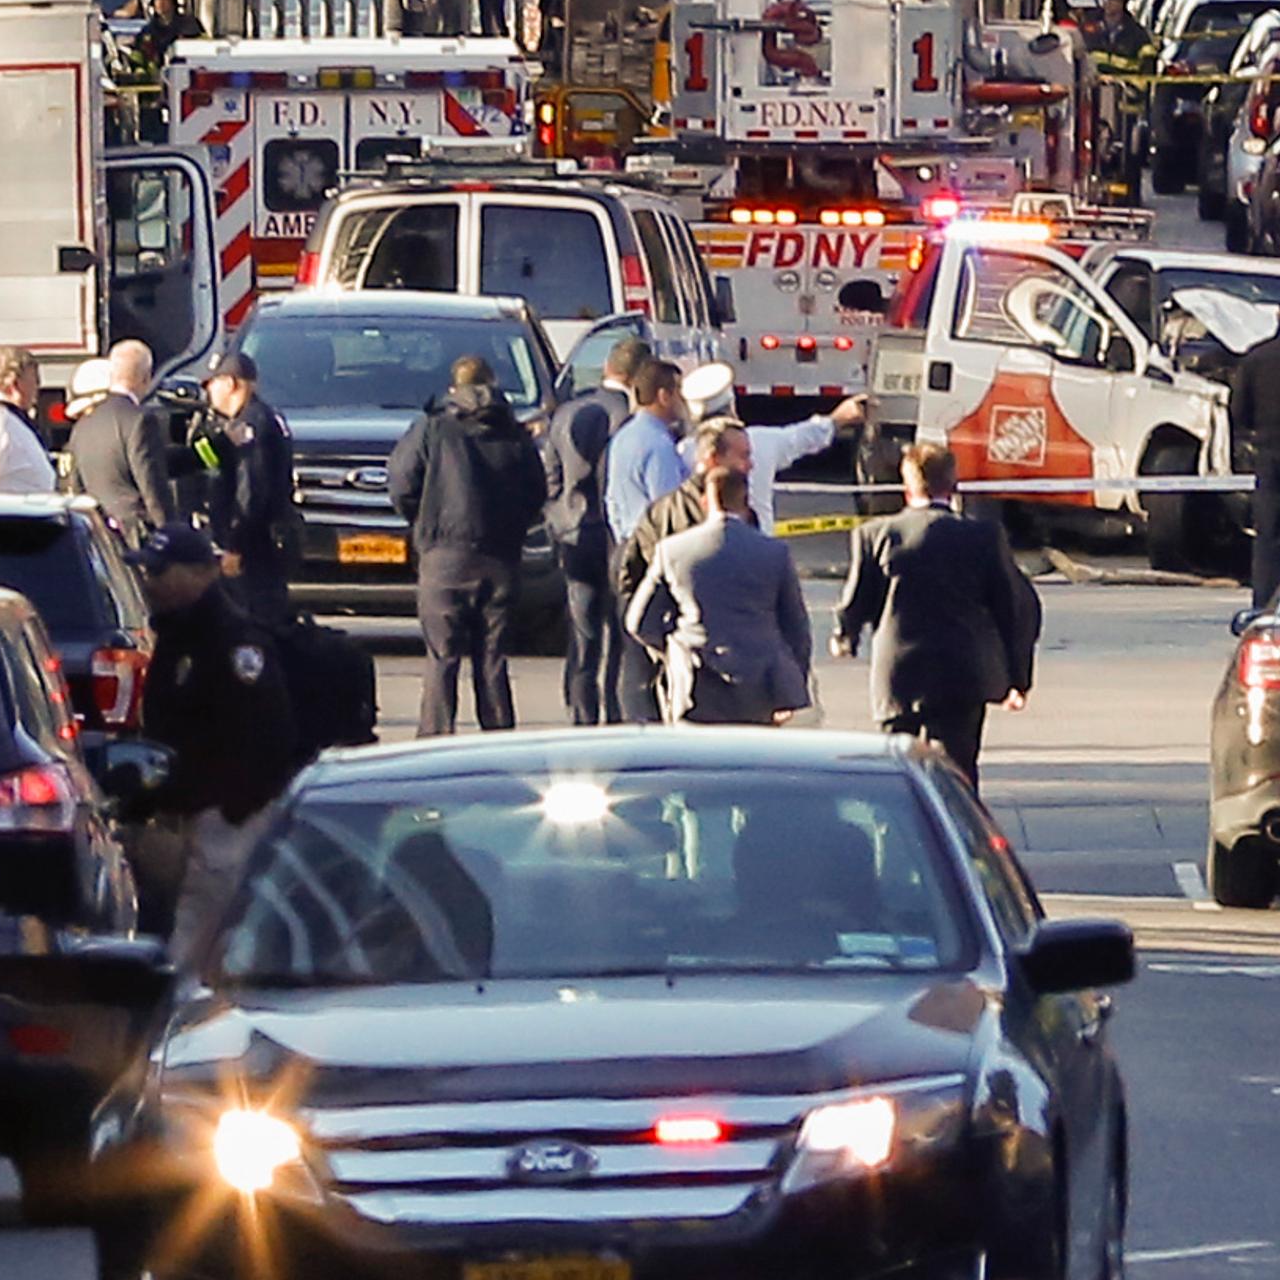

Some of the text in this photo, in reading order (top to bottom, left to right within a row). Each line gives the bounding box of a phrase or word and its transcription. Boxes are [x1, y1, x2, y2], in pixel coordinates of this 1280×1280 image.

[684, 33, 709, 91] 1
[913, 32, 939, 91] 1
[273, 99, 423, 127] F.D. N.Y.
[760, 100, 859, 128] F.D.N.Y.
[746, 231, 879, 269] FDNY
